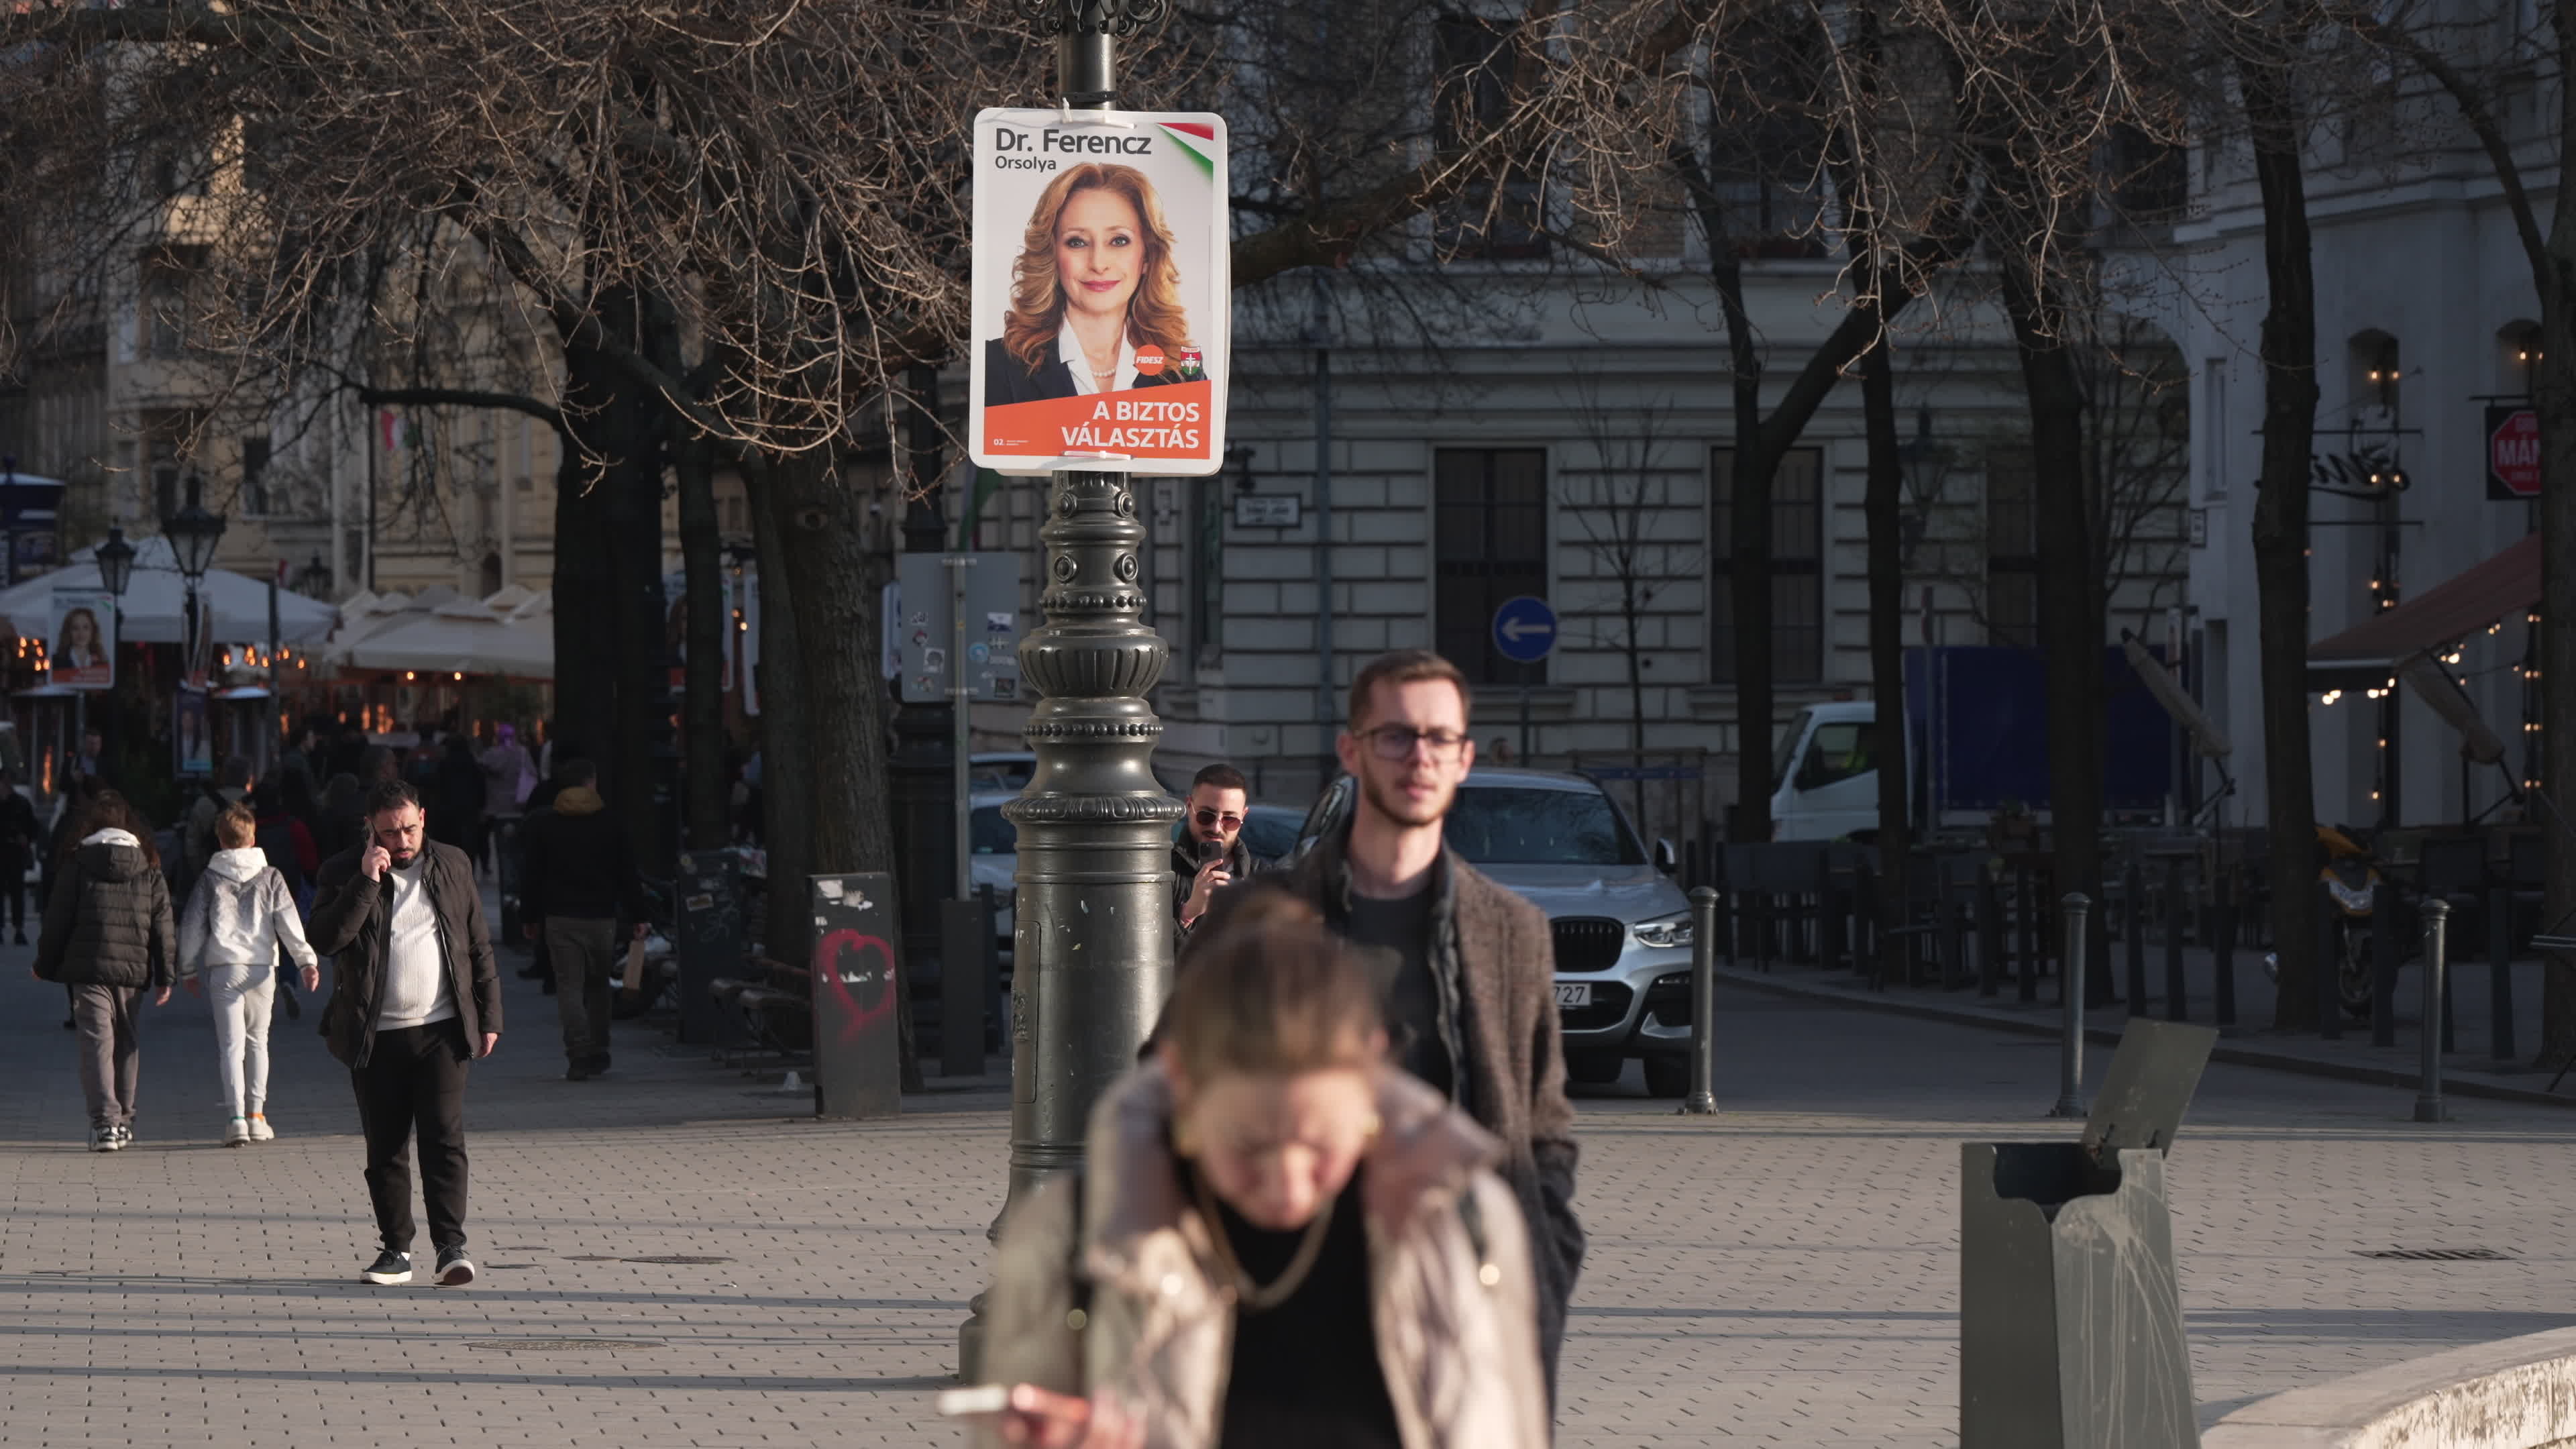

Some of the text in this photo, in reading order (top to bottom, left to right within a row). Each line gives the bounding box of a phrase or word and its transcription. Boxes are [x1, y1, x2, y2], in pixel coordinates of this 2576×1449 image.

[996, 128, 1152, 155] Dr. Ferencz
[995, 155, 1057, 173] Orsolya
[1136, 356, 1165, 364] FIDESZ
[1092, 400, 1200, 423] A BIZTOS
[1061, 421, 1200, 449] VÁLASZTÁS
